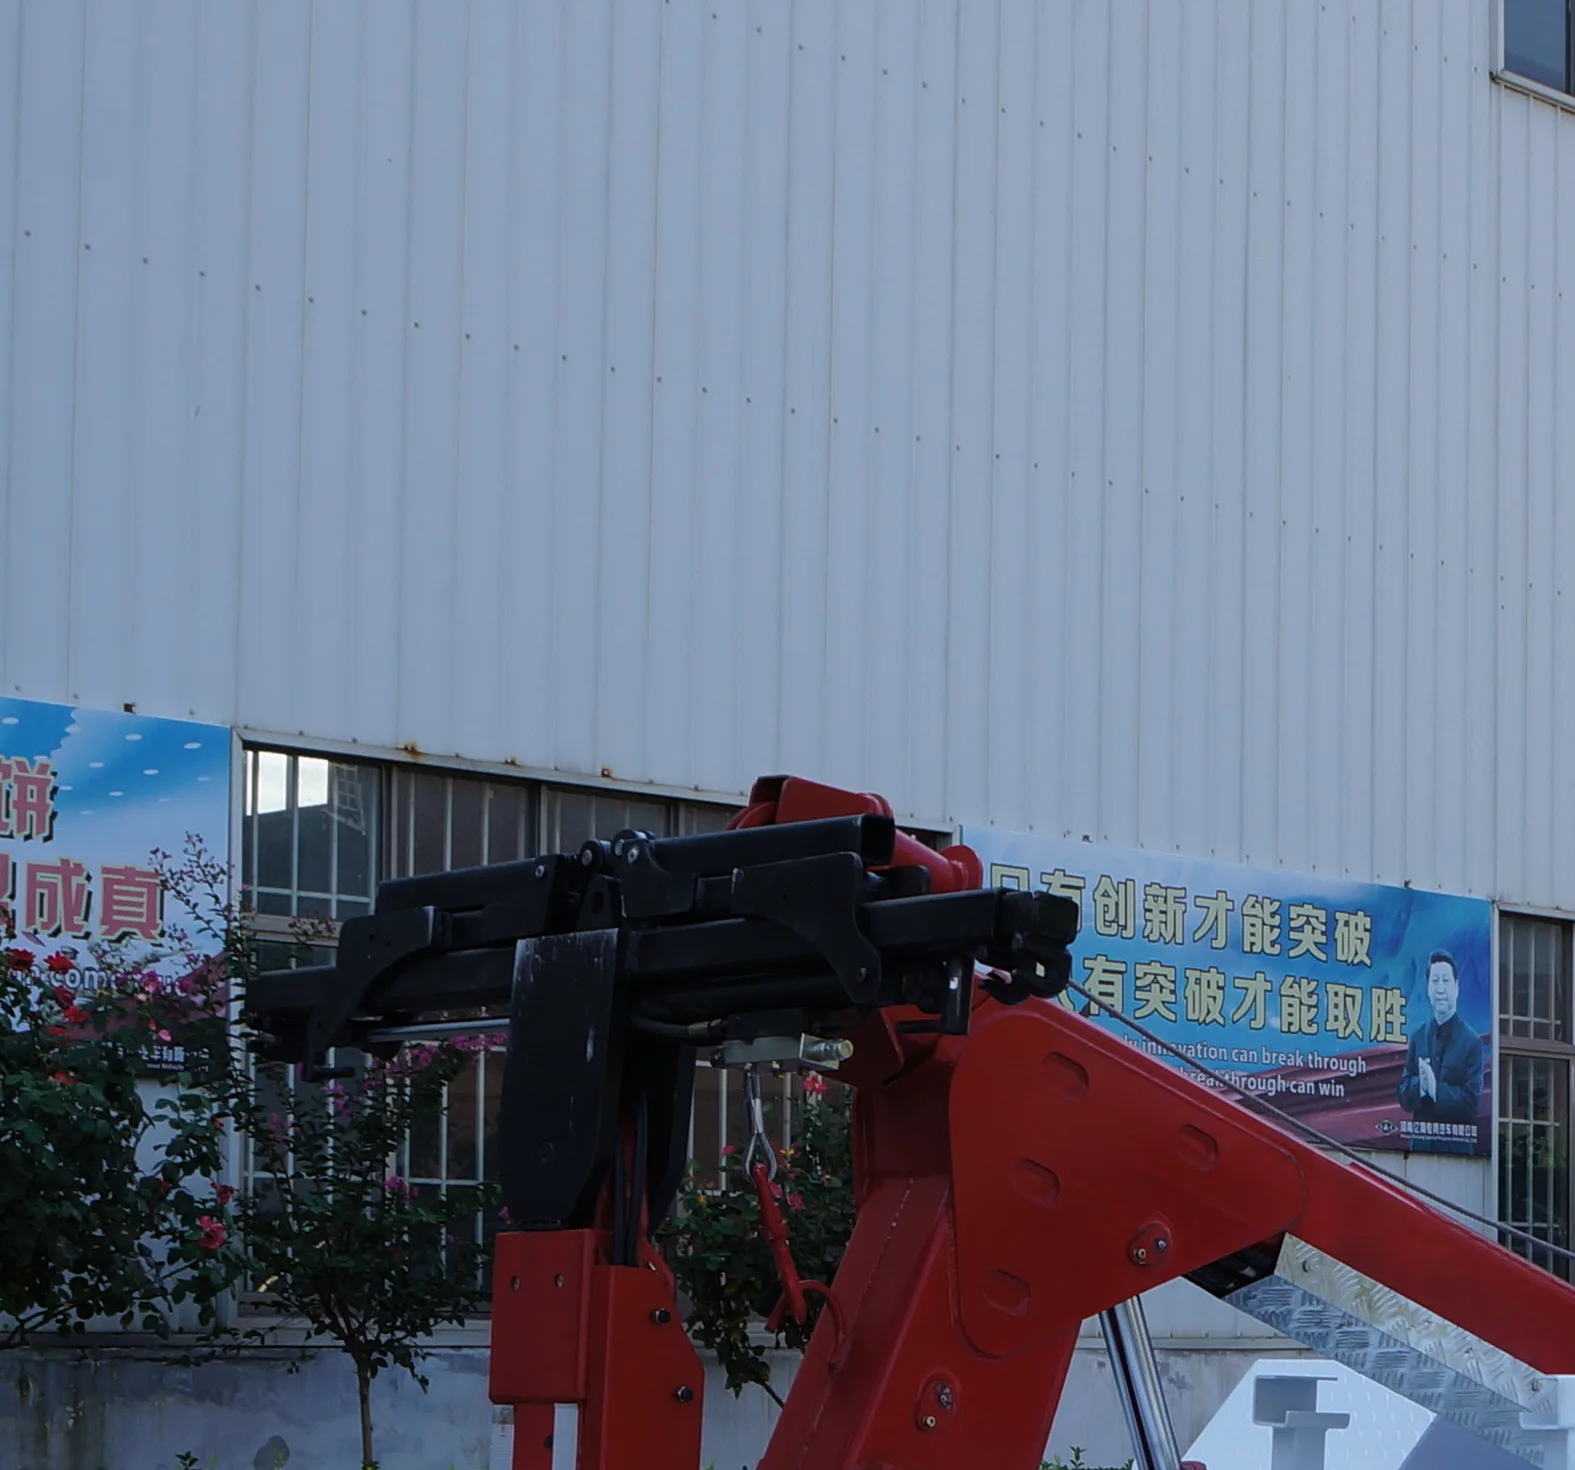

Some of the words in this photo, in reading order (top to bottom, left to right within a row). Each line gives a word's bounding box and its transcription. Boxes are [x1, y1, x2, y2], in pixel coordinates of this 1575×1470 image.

[1231, 1047, 1258, 1065] can
[1262, 1045, 1304, 1067] break
[1307, 1053, 1367, 1077] through
[1289, 1078, 1315, 1095] can
[1319, 1080, 1345, 1097] win
